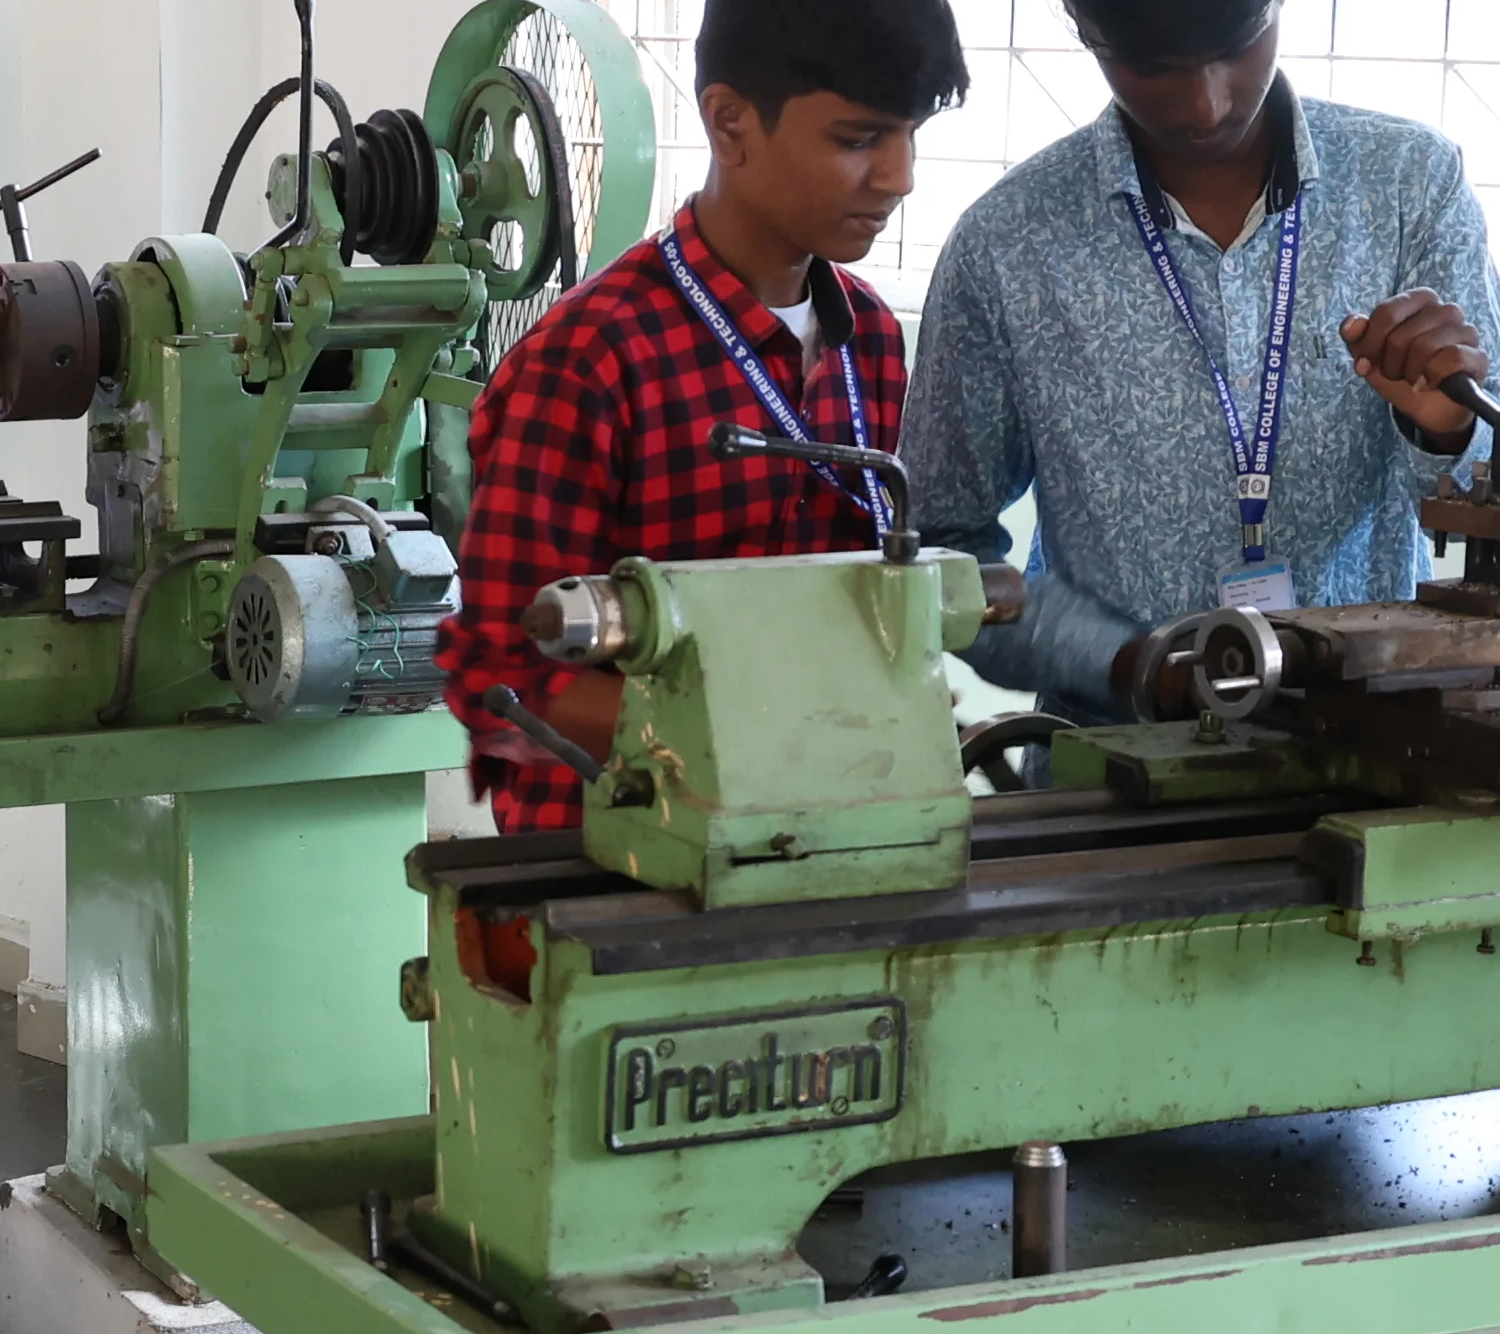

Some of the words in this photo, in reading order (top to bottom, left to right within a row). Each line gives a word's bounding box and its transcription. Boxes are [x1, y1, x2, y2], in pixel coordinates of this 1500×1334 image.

[1152, 241, 1164, 253] &
[1283, 233, 1294, 244] &
[1272, 248, 1293, 345] ENGINEERING
[734, 345, 747, 359] &
[1269, 351, 1281, 368] OF
[1214, 371, 1239, 437] COLLEGE
[1260, 371, 1280, 437] COLLEGE
[853, 417, 862, 429] &
[1234, 440, 1248, 472] SBM
[1255, 440, 1269, 472] SBM
[625, 1032, 881, 1130] Preciturn
